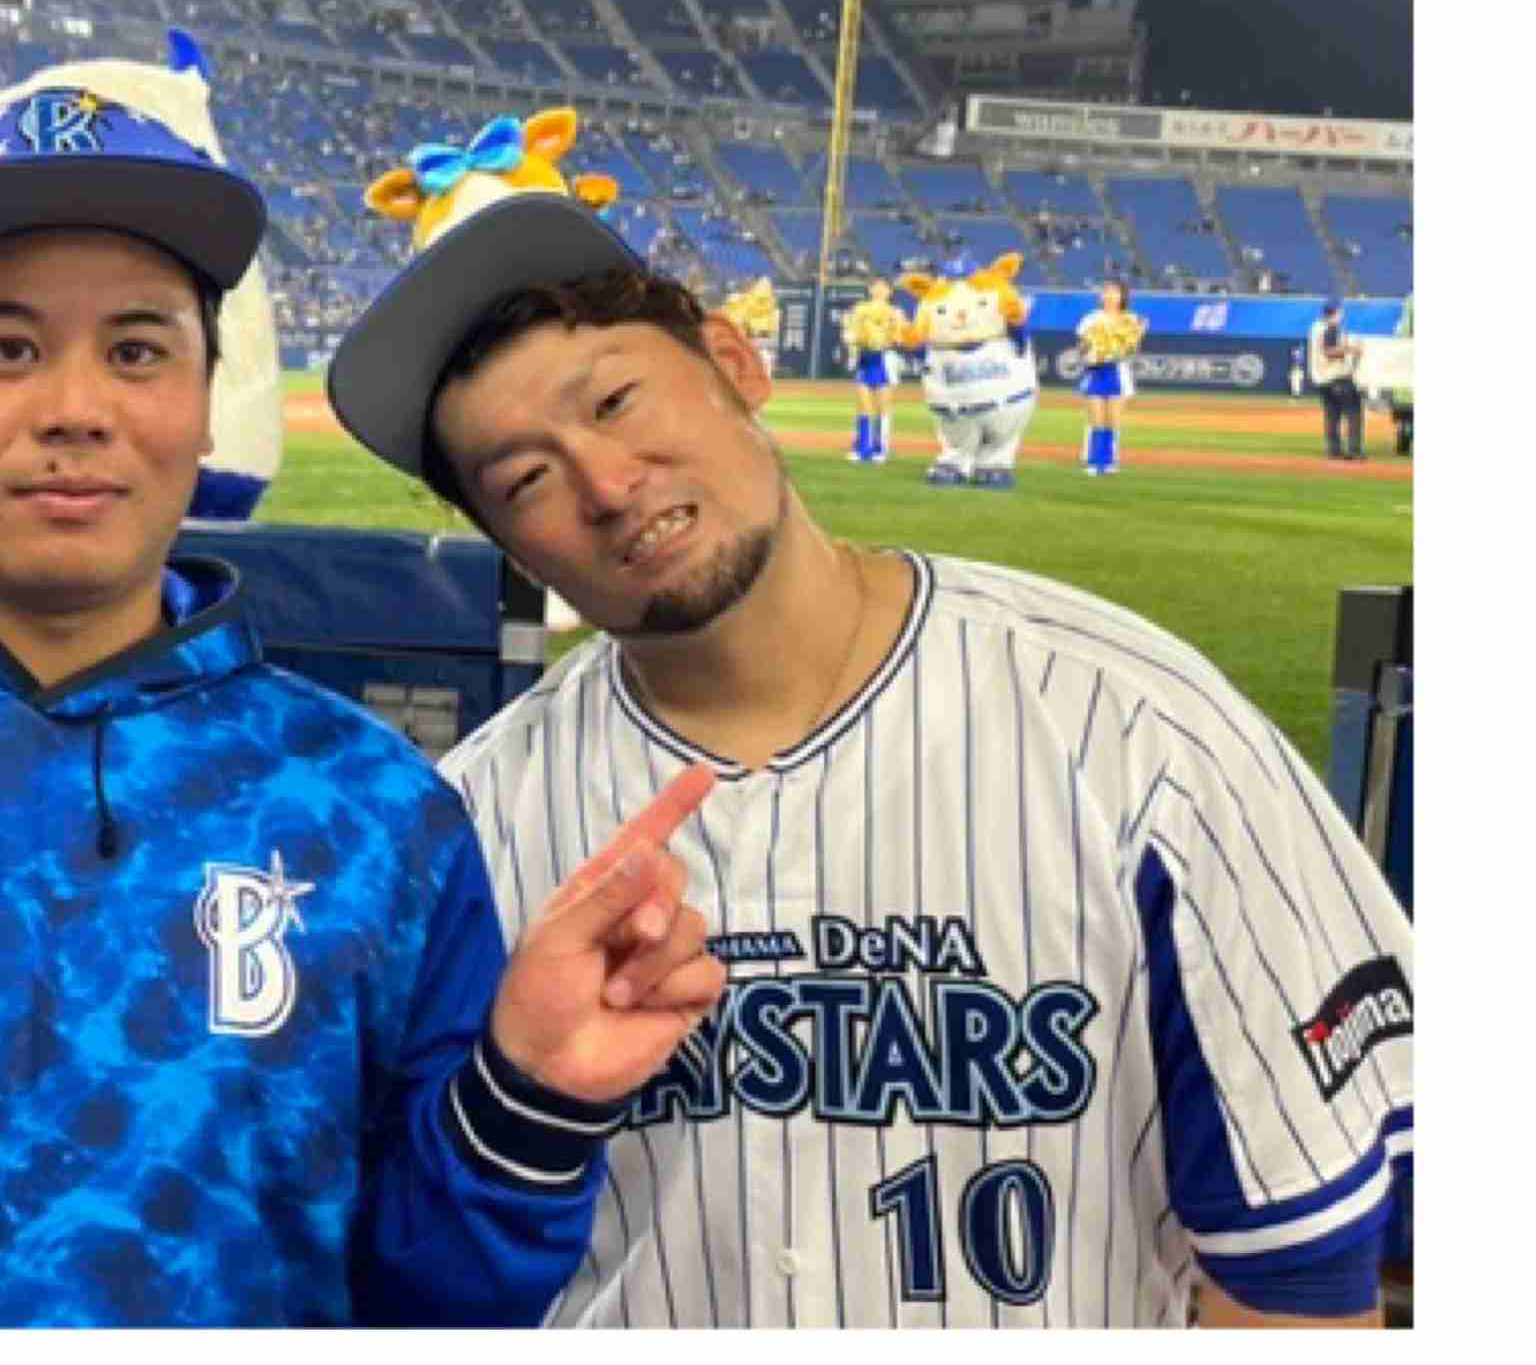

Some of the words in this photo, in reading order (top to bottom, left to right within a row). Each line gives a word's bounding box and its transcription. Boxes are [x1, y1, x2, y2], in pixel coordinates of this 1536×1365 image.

[194, 859, 300, 1037] B
[814, 916, 987, 975] DeNA
[871, 1152, 1056, 1306] 10
